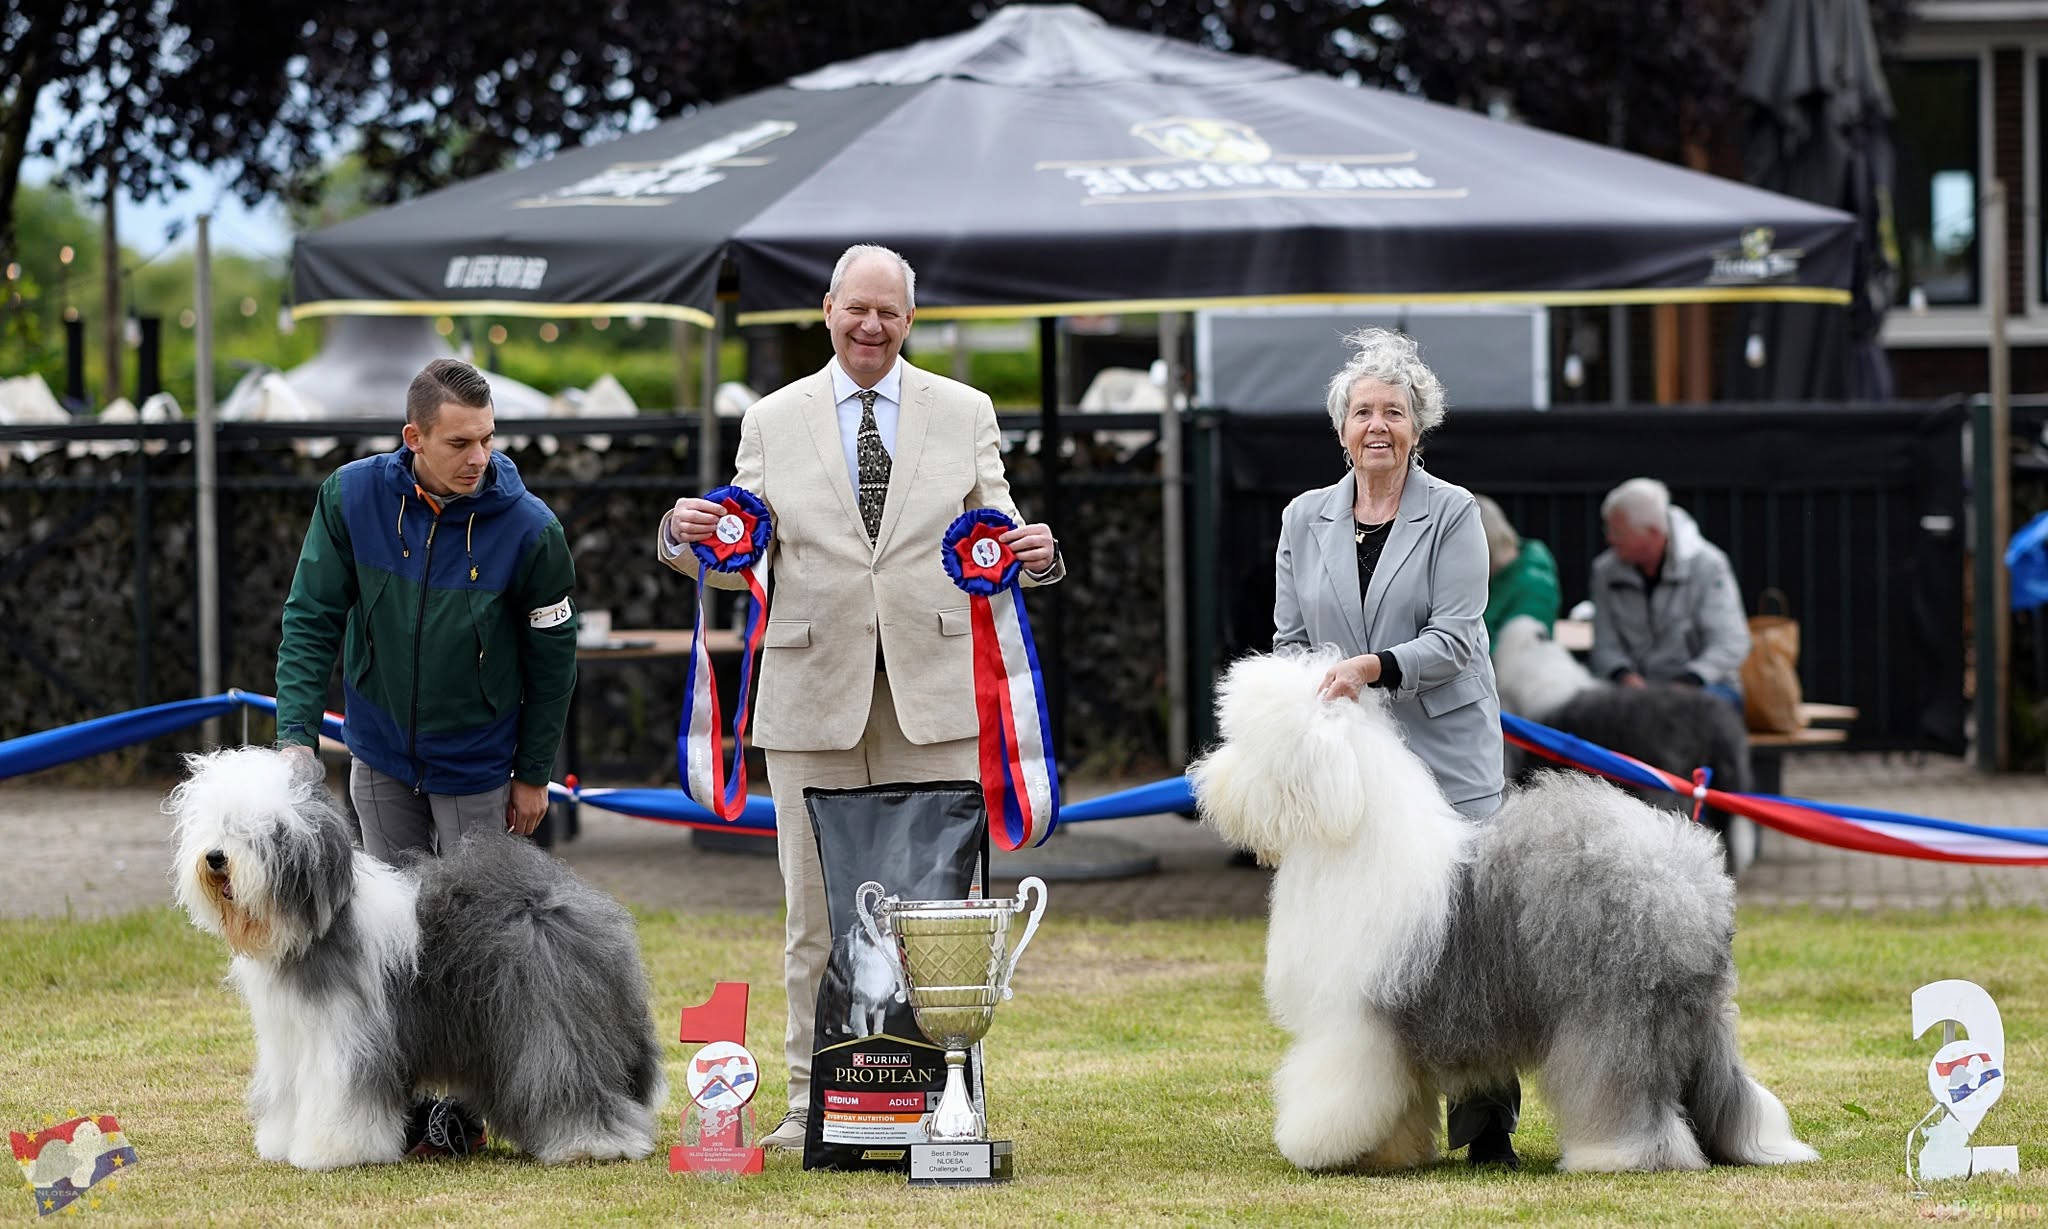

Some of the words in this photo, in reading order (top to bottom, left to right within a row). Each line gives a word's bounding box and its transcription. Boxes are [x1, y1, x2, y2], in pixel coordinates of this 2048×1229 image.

[553, 607, 567, 622] 18
[866, 1055, 908, 1064] PURINA
[835, 1067, 874, 1083] PRO
[877, 1068, 932, 1083] PLAN
[1911, 979, 2019, 1178] 2
[827, 1095, 859, 1105] MEDIUM
[889, 1098, 920, 1106] ADULT
